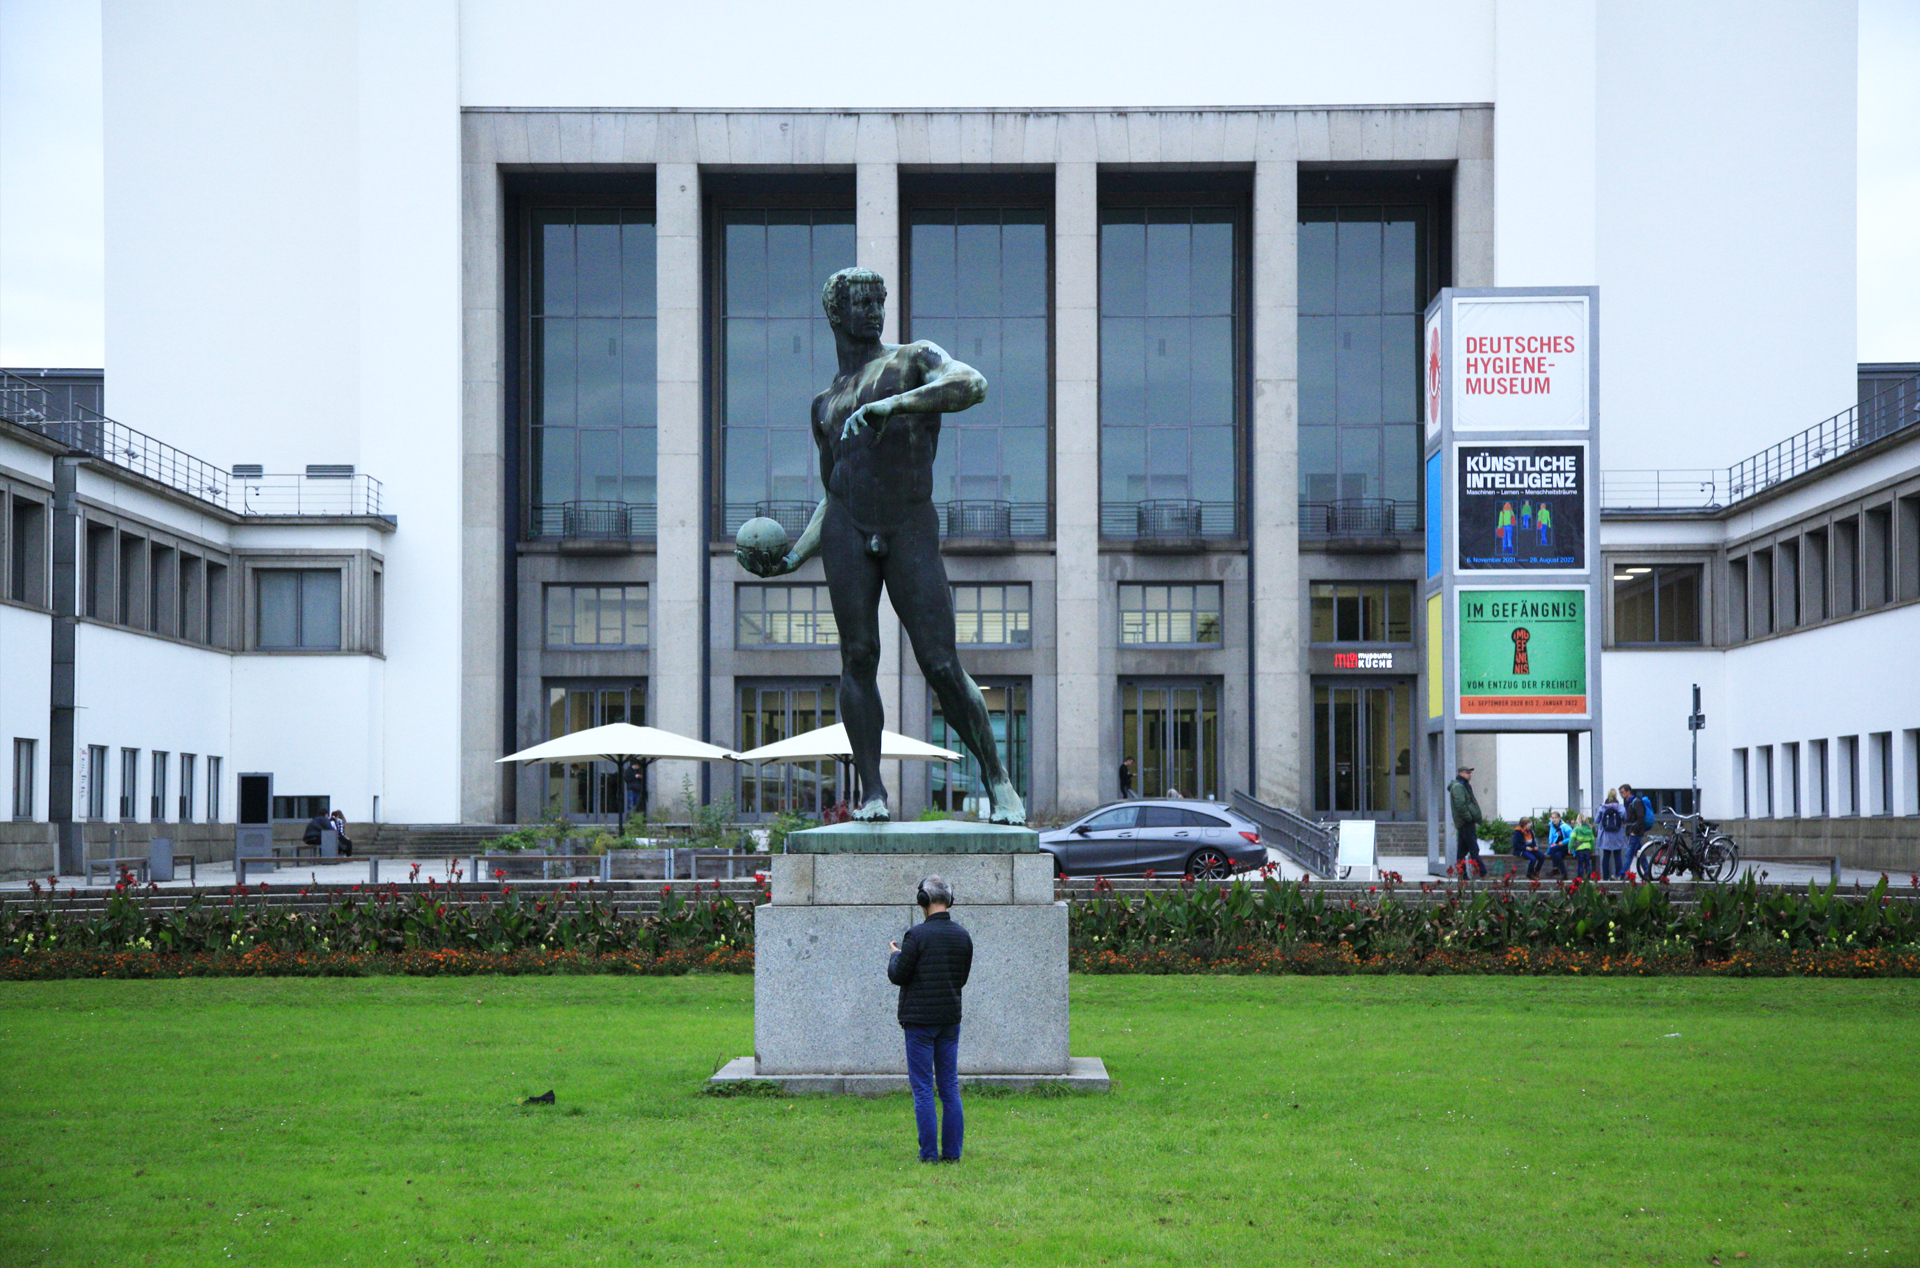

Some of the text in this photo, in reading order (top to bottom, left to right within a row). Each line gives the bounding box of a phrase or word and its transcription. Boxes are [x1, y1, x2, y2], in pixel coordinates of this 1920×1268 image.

[1466, 336, 1575, 354] DEUTSCHES
[1466, 357, 1555, 374] HYGIENE-
[1466, 377, 1551, 395] MUSEUM
[1466, 452, 1576, 472] KÜNSTLICHE
[1466, 472, 1576, 488] INTELLIGENZ
[1467, 600, 1577, 618] IM GEFÄNGNIS
[1467, 680, 1578, 690] VOM ENTZUG DER FREIHEIT
[1565, 699, 1578, 707] 2022
